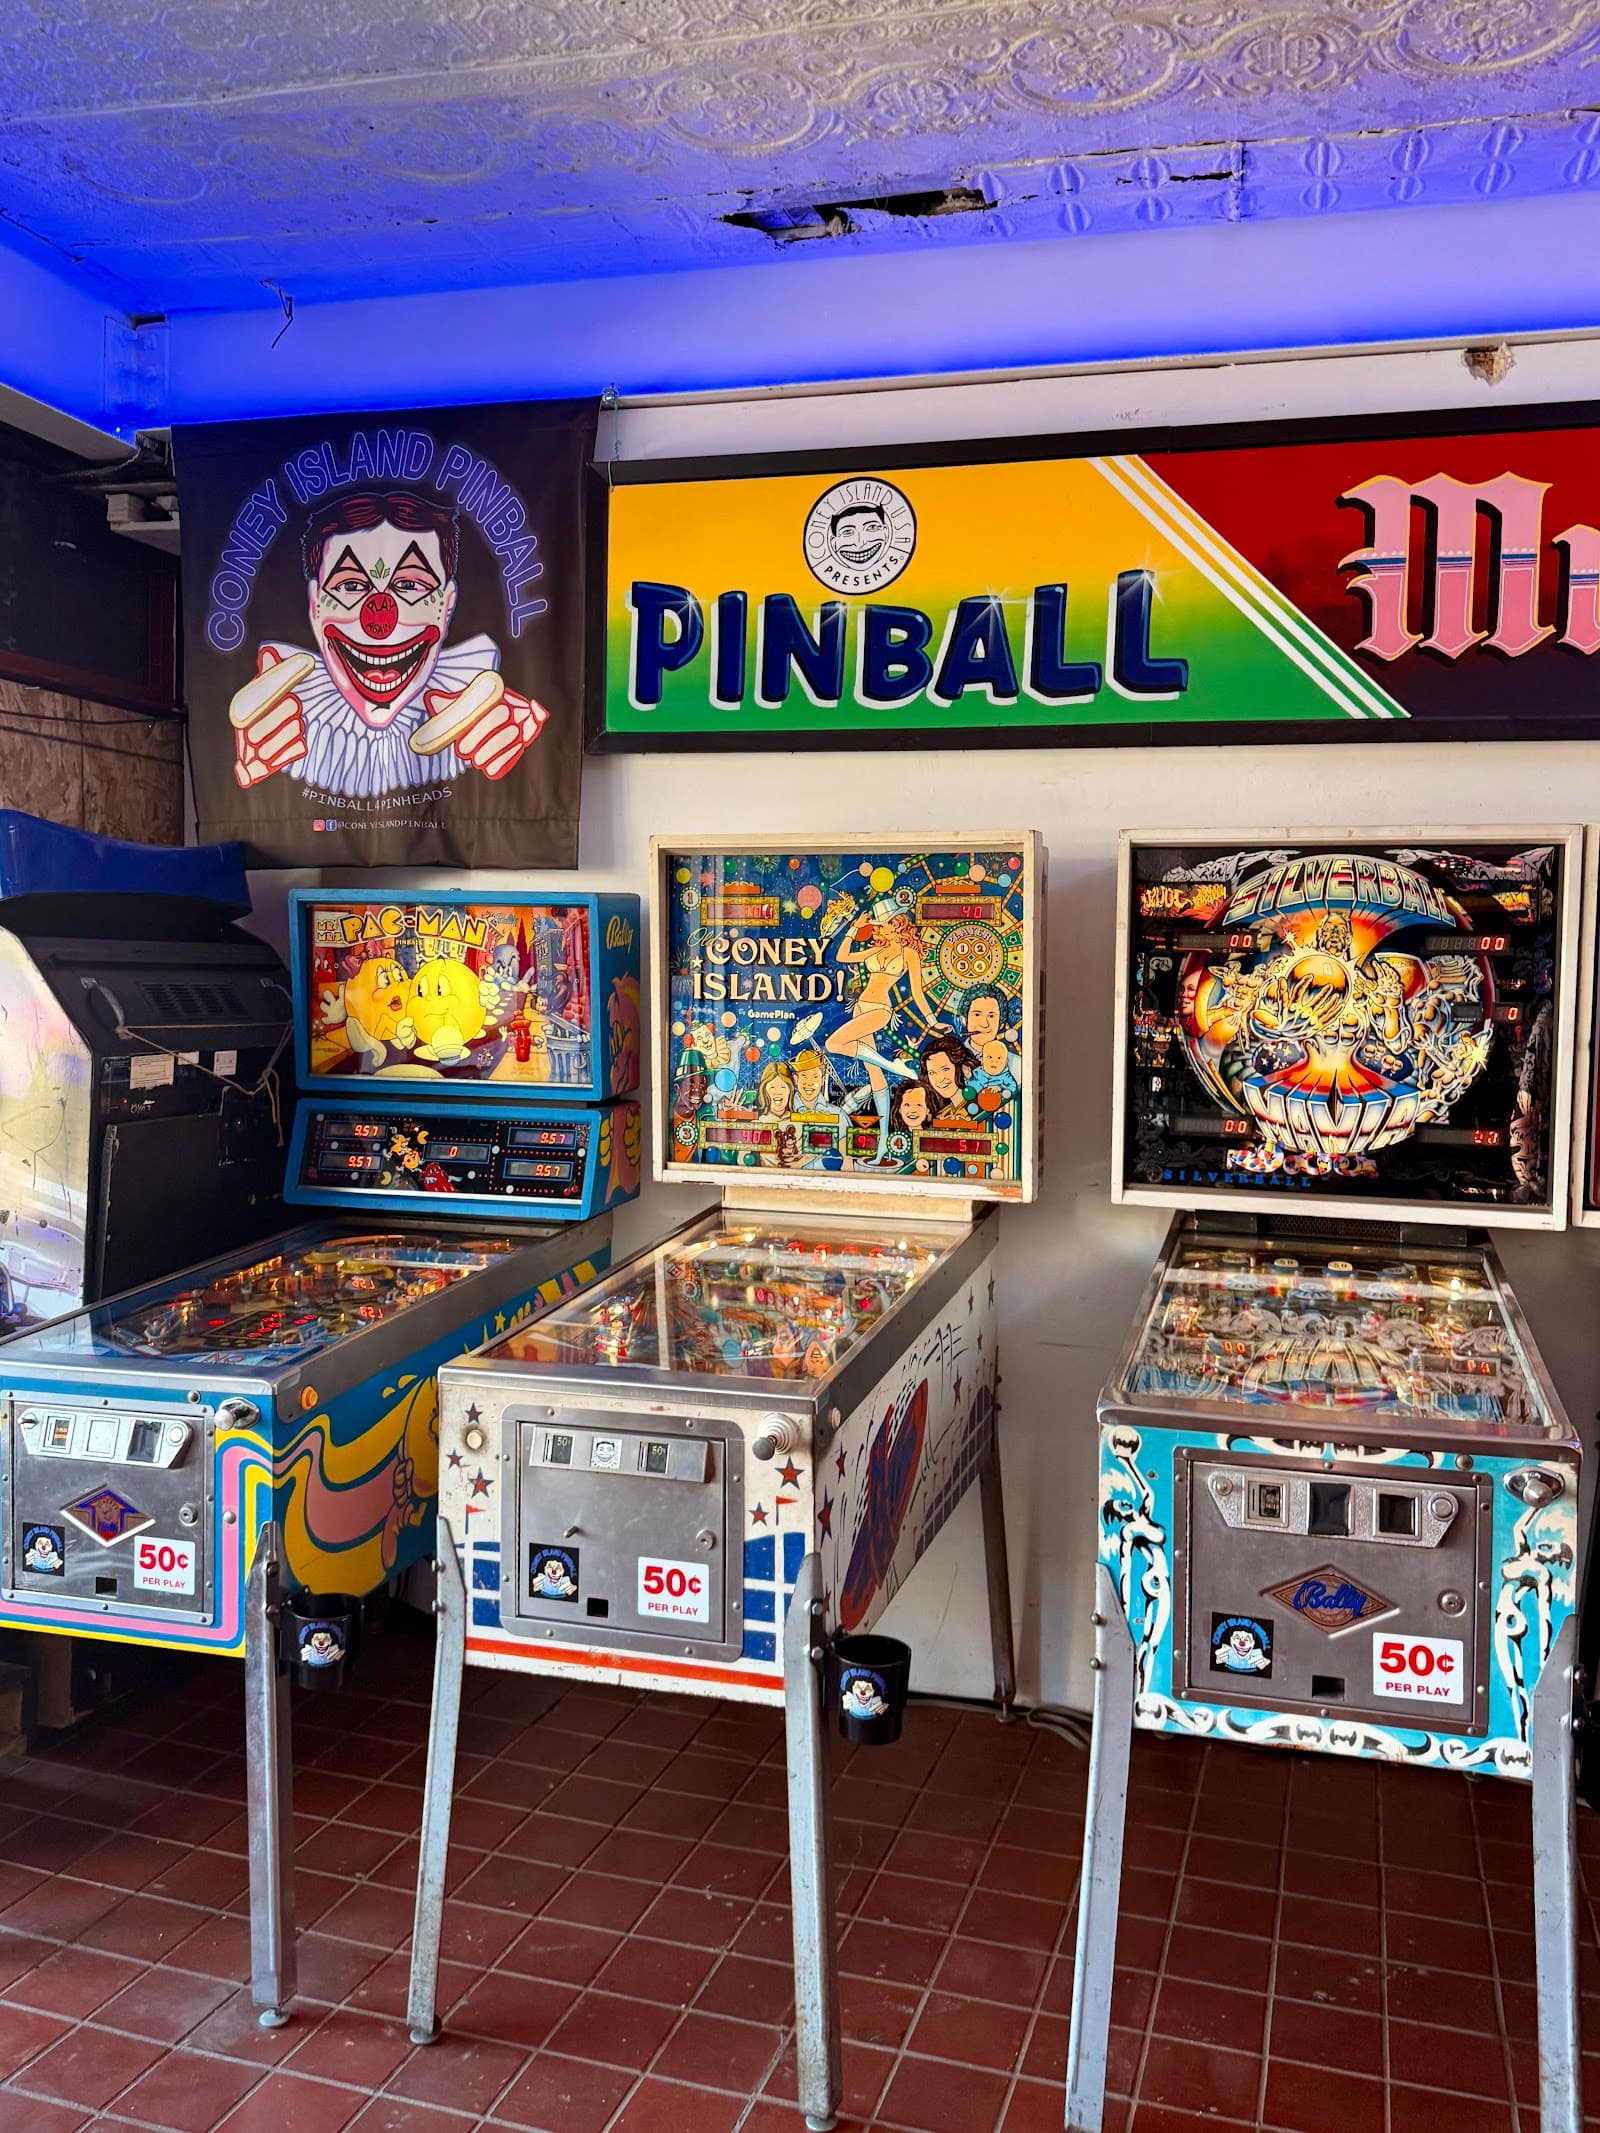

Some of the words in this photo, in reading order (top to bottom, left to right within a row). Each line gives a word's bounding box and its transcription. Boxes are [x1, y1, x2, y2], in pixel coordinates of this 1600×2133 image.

[207, 478, 288, 653] CONEY
[283, 429, 434, 505] ISLAND
[435, 444, 548, 639] PINBALL
[823, 555, 898, 587] PRESENTS
[367, 597, 395, 615] PLAY
[626, 569, 1190, 711] PINBALL
[1222, 857, 1457, 929] SILVERBALL
[338, 904, 490, 950] PAC-MAN
[606, 915, 634, 953] Bally
[706, 937, 831, 967] CONEY
[692, 969, 846, 1003] ISLAND!
[747, 1009, 796, 1020] GamePlan
[1242, 1082, 1421, 1154] MANIA
[448, 1145, 459, 1159] 0
[1162, 1168, 1311, 1188] SILVERBALL
[139, 1543, 189, 1573] 50¢
[142, 1576, 160, 1585] PER
[163, 1579, 186, 1588] PLAY
[643, 1565, 702, 1597] 50¢
[648, 1602, 668, 1612] PER
[672, 1605, 698, 1616] PLAY
[1293, 1580, 1367, 1619] Bally
[1380, 1641, 1454, 1677] 50¢
[1385, 1682, 1412, 1693] PER
[1417, 1684, 1450, 1697] PLAY
